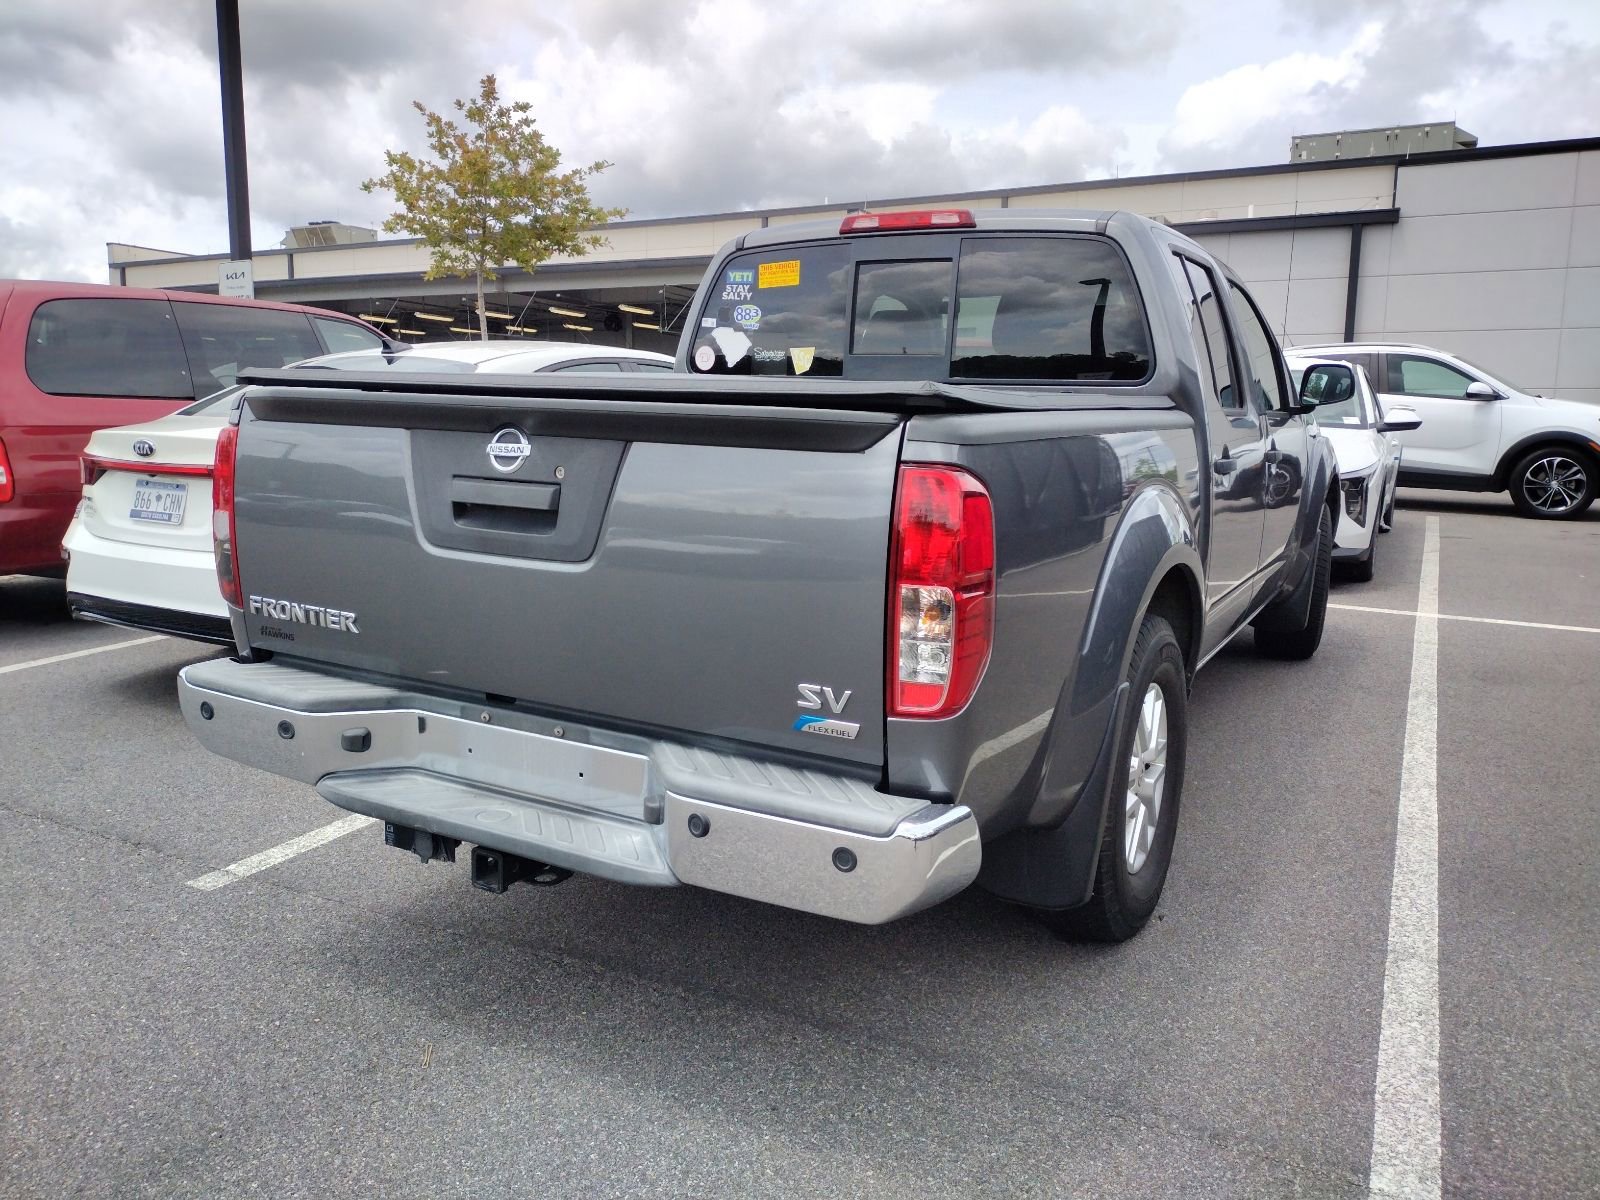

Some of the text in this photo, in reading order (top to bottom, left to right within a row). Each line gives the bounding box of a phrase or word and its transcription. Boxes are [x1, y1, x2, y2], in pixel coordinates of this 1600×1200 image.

[774, 261, 799, 269] VEHICLE
[226, 271, 245, 280] KIA
[728, 271, 753, 282] YETI
[725, 284, 750, 293] STAY
[722, 292, 752, 300] SALTY
[134, 442, 151, 455] KIA
[489, 444, 525, 454] NISSAN
[134, 490, 183, 513] 866 CHN
[249, 595, 360, 634] FRONTIER
[260, 625, 295, 641] HAWKINS
[797, 683, 852, 714] SV
[808, 724, 853, 738] FLEX FUEL
